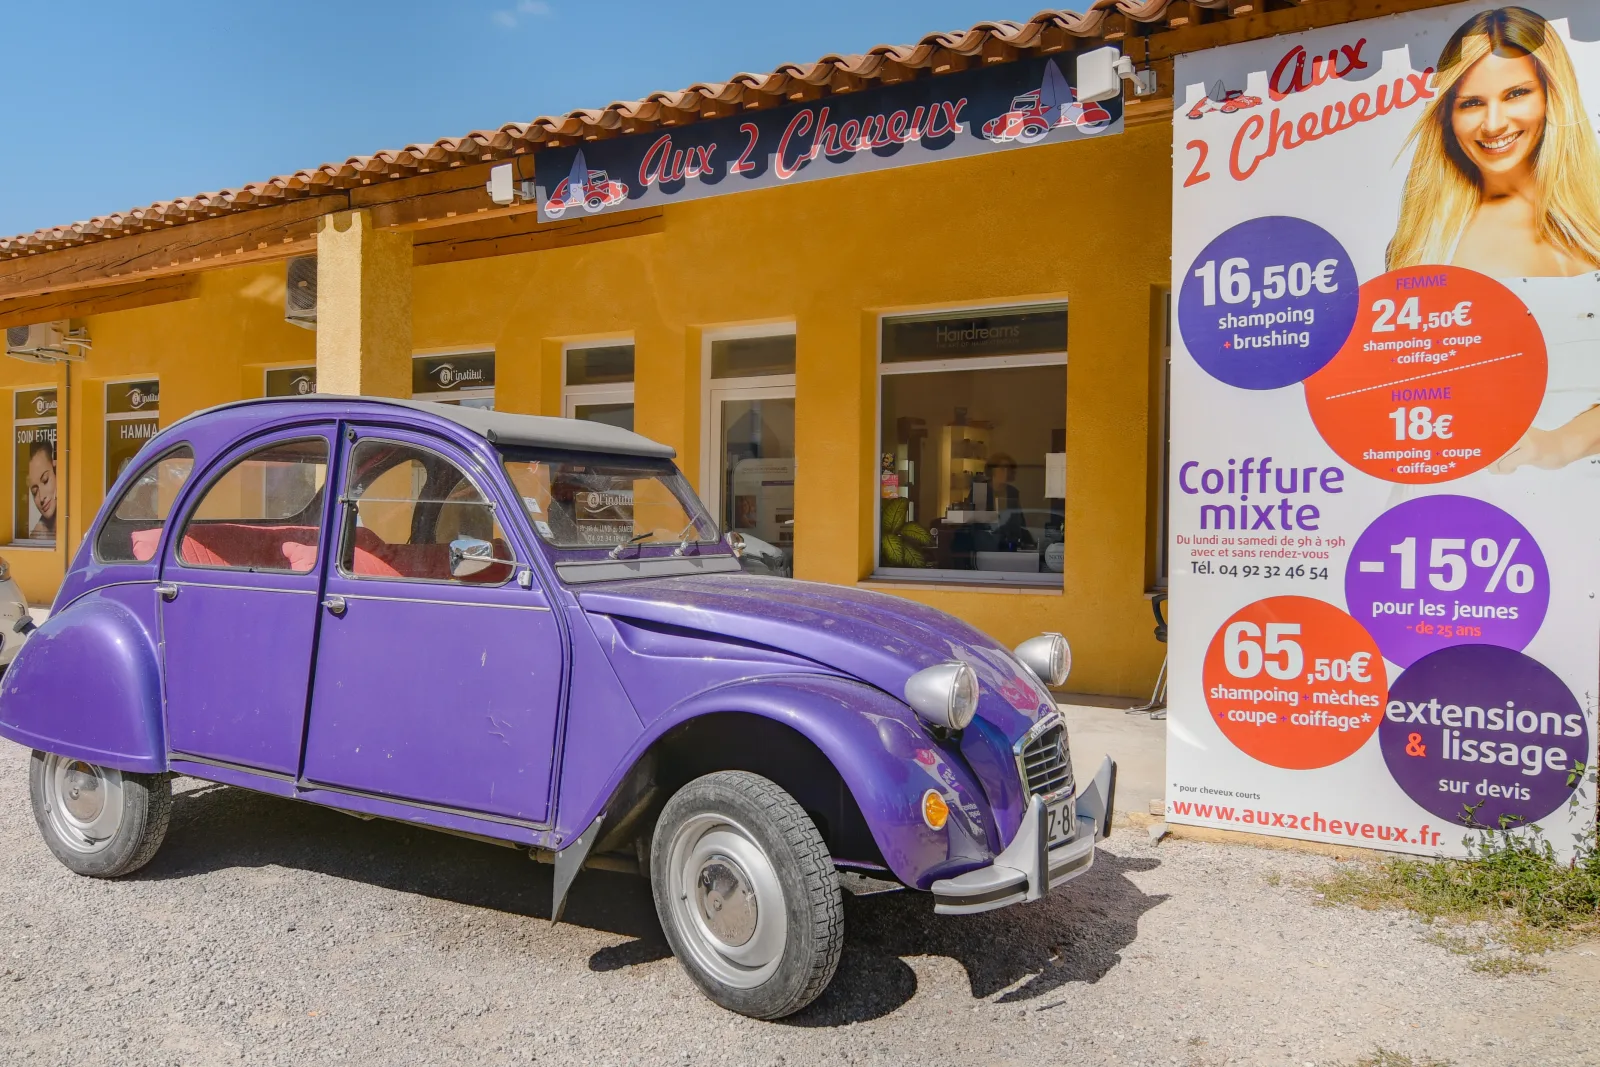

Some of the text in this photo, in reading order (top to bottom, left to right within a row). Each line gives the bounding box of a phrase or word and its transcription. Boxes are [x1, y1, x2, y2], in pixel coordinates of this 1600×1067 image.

[1268, 37, 1368, 102] Aux
[1183, 66, 1436, 188] 2 Cheveux
[639, 98, 967, 186] Aux 2 Cheveux
[1195, 256, 1339, 308] 16,50€
[1396, 274, 1447, 291] FEMME
[1218, 306, 1315, 332] shampoing
[1371, 296, 1472, 333] 24,50€
[937, 322, 1019, 342] Hairdreams
[1363, 337, 1431, 352] shampoing
[1442, 334, 1482, 347] coupe
[1391, 386, 1451, 402] HOMME
[120, 423, 158, 439] HAMMA
[1389, 406, 1453, 441] 18€
[17, 429, 57, 443] SOIN ESTHE
[1363, 448, 1431, 462] shampoing
[1442, 448, 1481, 460] coupe
[1179, 457, 1345, 495] Coiffure
[1200, 495, 1320, 531] mixte
[1177, 535, 1346, 549] Du lundi au samedi de 9h à 19h
[1191, 548, 1329, 559] avec et sans rendez-vous
[1191, 561, 1328, 580] Tél. 04 92 32 46 54
[1359, 536, 1535, 594] -15%
[1372, 599, 1519, 620] pour les jeunes
[1415, 622, 1434, 636] de
[1437, 624, 1453, 638] 25
[1455, 626, 1482, 637] ans
[1223, 621, 1372, 685] 65,50€
[1210, 684, 1299, 706] shampoing
[1312, 689, 1379, 707] mèches
[1227, 709, 1277, 725] coupe
[1385, 698, 1583, 738] extensions
[1405, 729, 1568, 776] & lissage
[1179, 785, 1197, 795] pour
[1199, 786, 1233, 798] cheveux
[1235, 790, 1261, 800] courts
[1438, 778, 1531, 801] sur devis
[1173, 800, 1441, 847] www.aux2cheveux.fr
